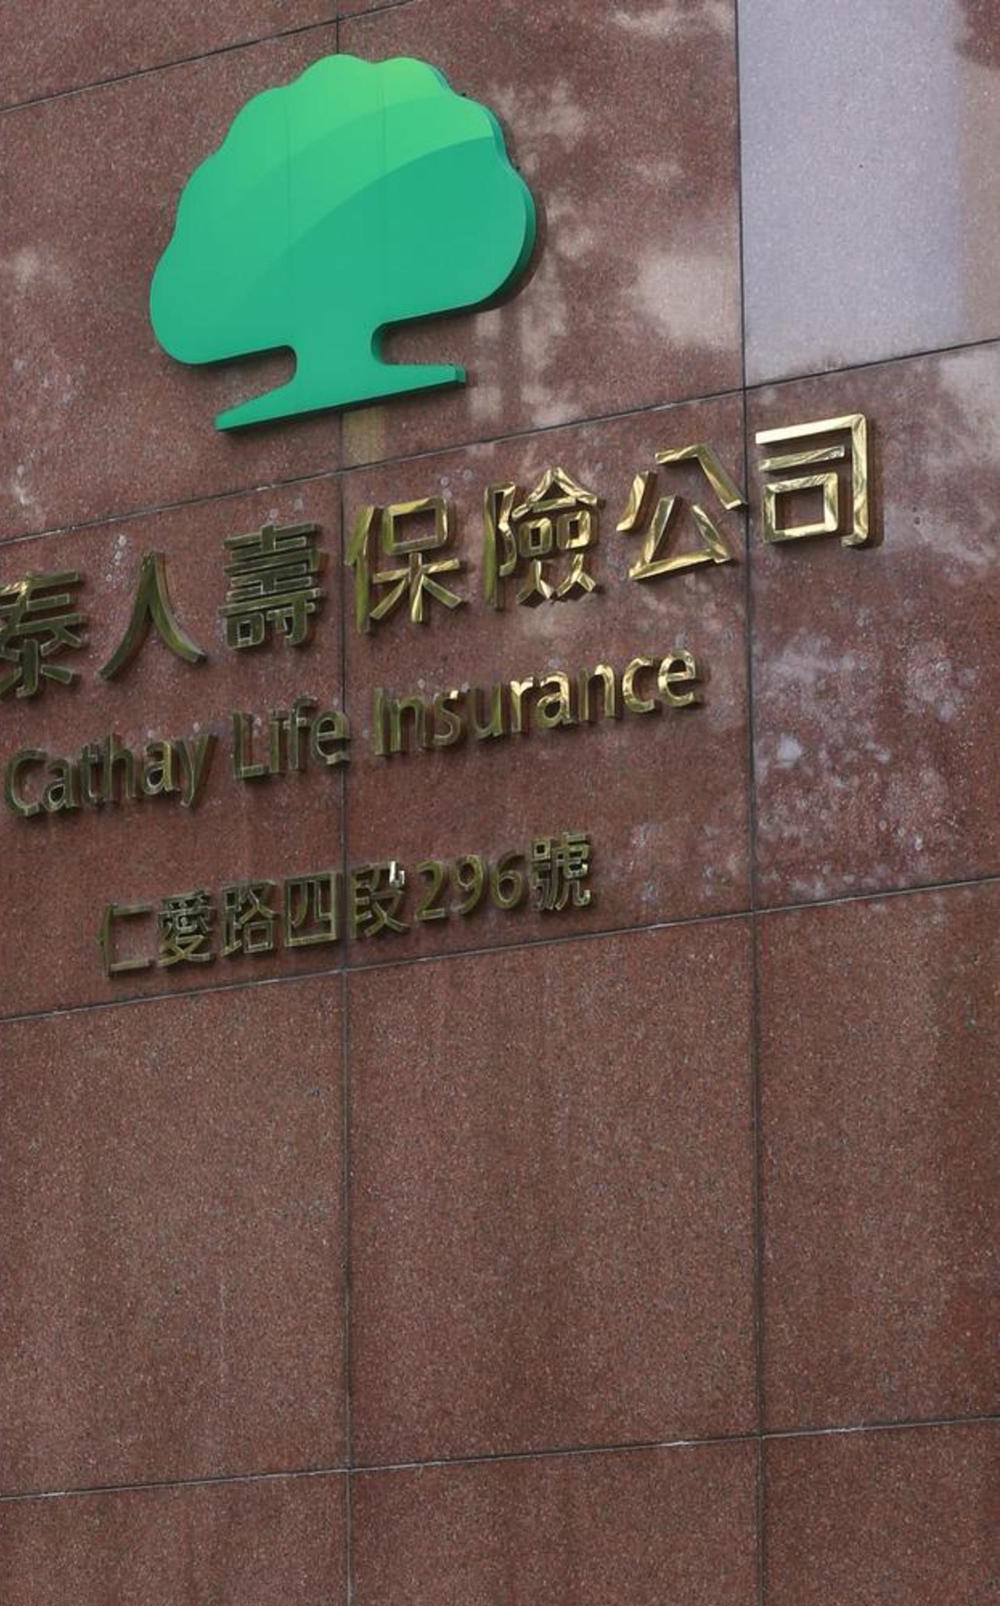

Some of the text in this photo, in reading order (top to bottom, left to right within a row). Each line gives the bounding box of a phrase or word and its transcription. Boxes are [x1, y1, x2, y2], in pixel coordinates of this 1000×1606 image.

[3, 649, 703, 819] Cathay Life Insurance
[97, 831, 593, 977] 仁愛路四段296號
